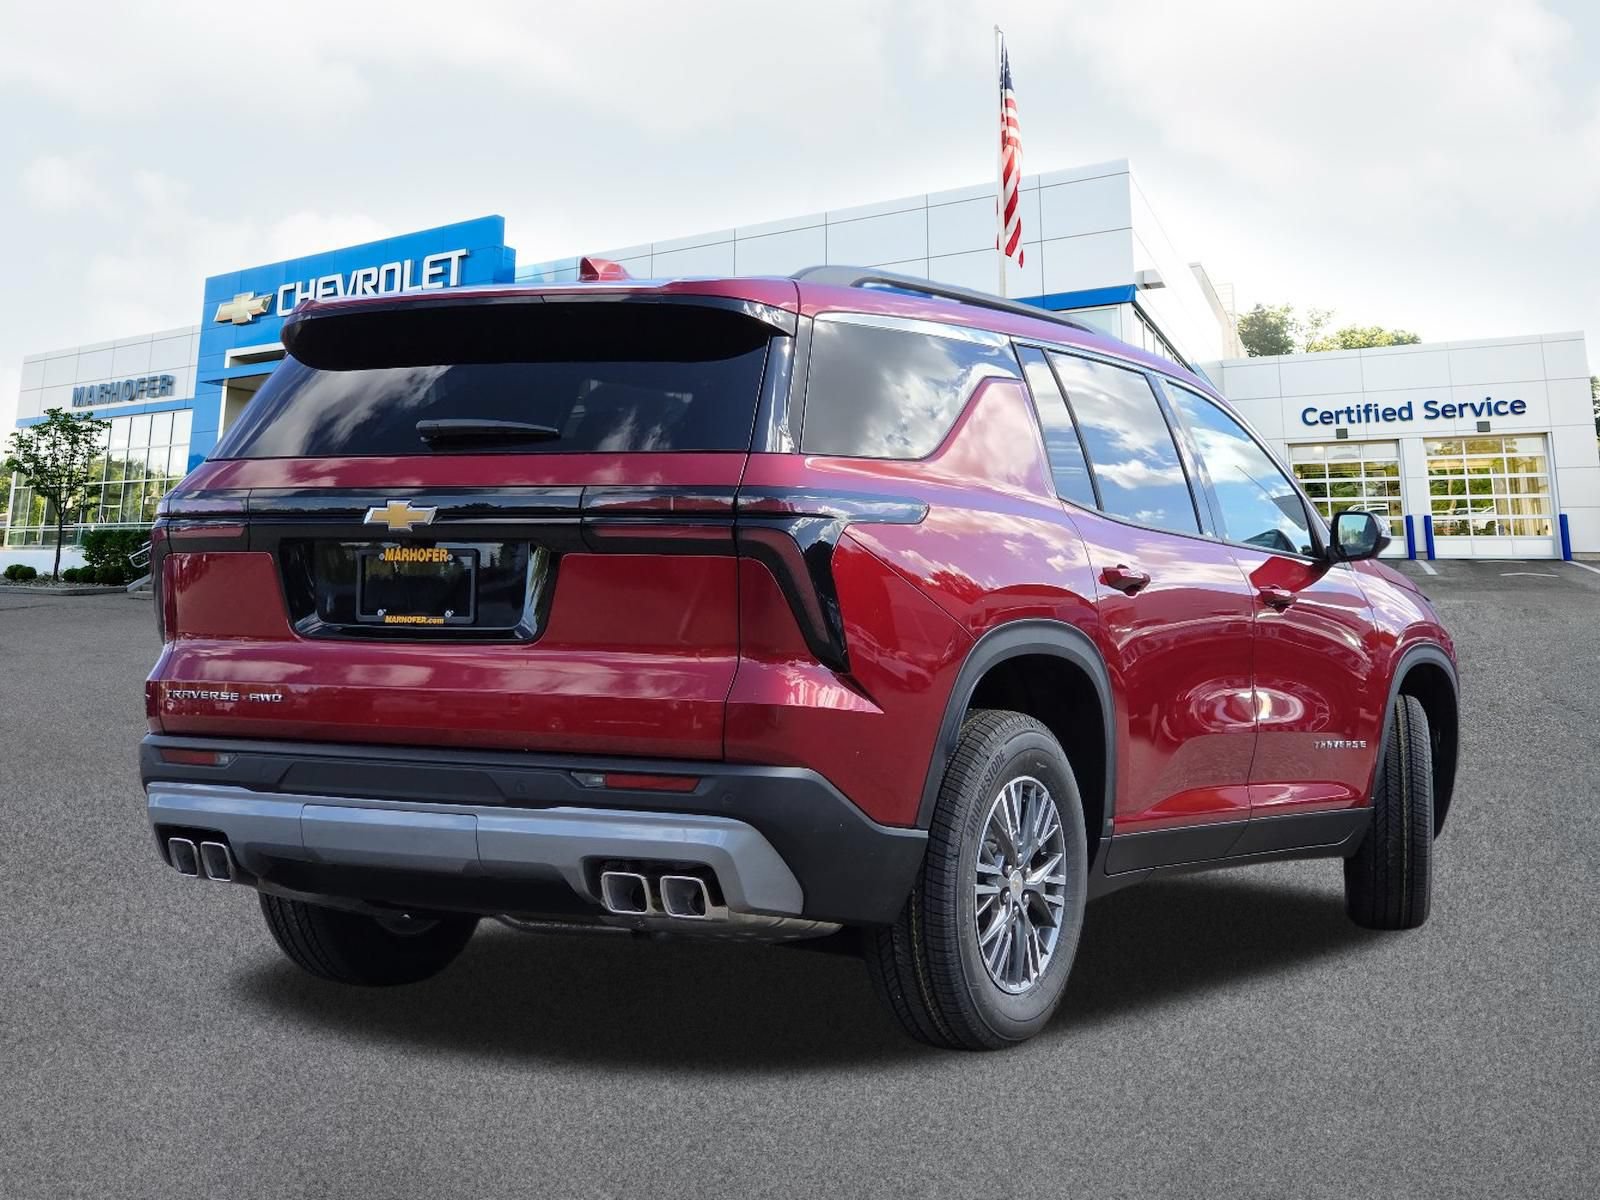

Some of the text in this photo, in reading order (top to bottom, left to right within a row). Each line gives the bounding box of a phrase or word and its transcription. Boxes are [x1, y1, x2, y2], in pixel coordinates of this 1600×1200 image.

[277, 248, 469, 317] CHEVROLET
[72, 375, 176, 407] MARHOFER
[1301, 396, 1527, 426] Certified Service
[384, 547, 448, 562] MARHOFER
[384, 615, 444, 624] MARHOFER.com
[166, 689, 282, 702] TRAVERSE AWD
